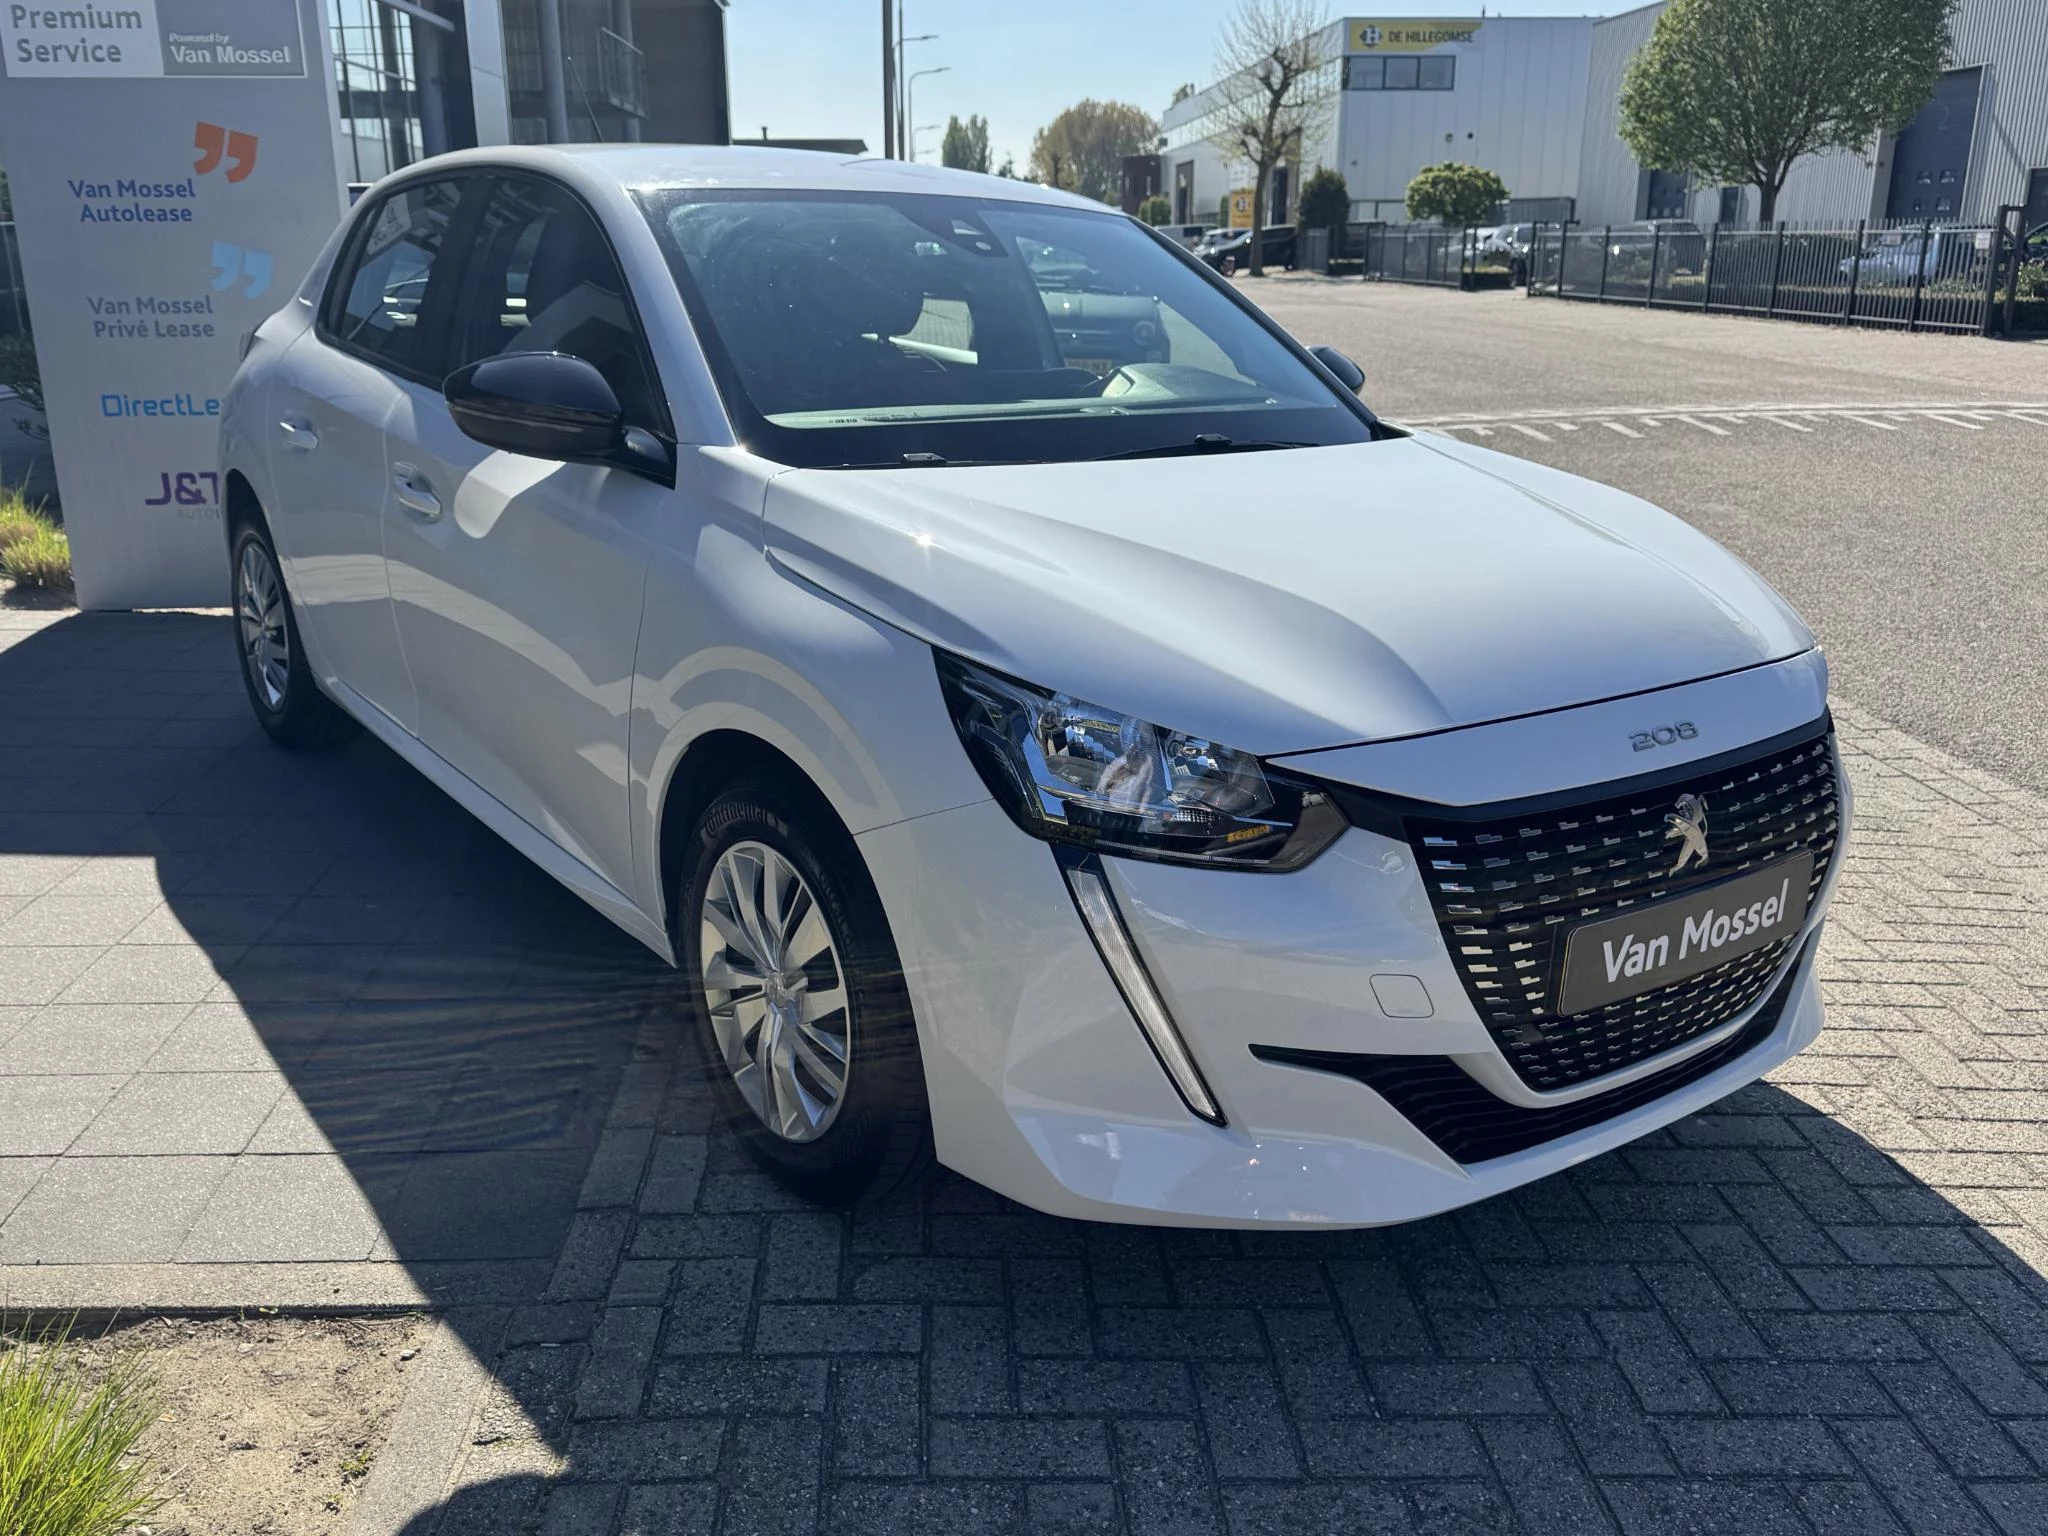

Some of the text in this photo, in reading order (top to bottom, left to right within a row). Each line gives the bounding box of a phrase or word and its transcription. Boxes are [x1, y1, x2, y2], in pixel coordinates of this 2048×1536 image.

[11, 4, 142, 29] Premium
[169, 32, 230, 44] Powered by
[1388, 30, 1402, 43] DE
[1405, 30, 1473, 43] HILLEGOMSE
[16, 37, 122, 63] Service
[170, 45, 290, 64] Van Mossel
[68, 178, 196, 198] Van Mossel
[80, 203, 192, 222] Autolease
[87, 295, 213, 315] Van Mossel
[94, 319, 215, 338] Privé Lease
[1628, 720, 1700, 753] 208
[704, 800, 767, 838] Continental
[1602, 878, 1789, 983] Van Mossel
